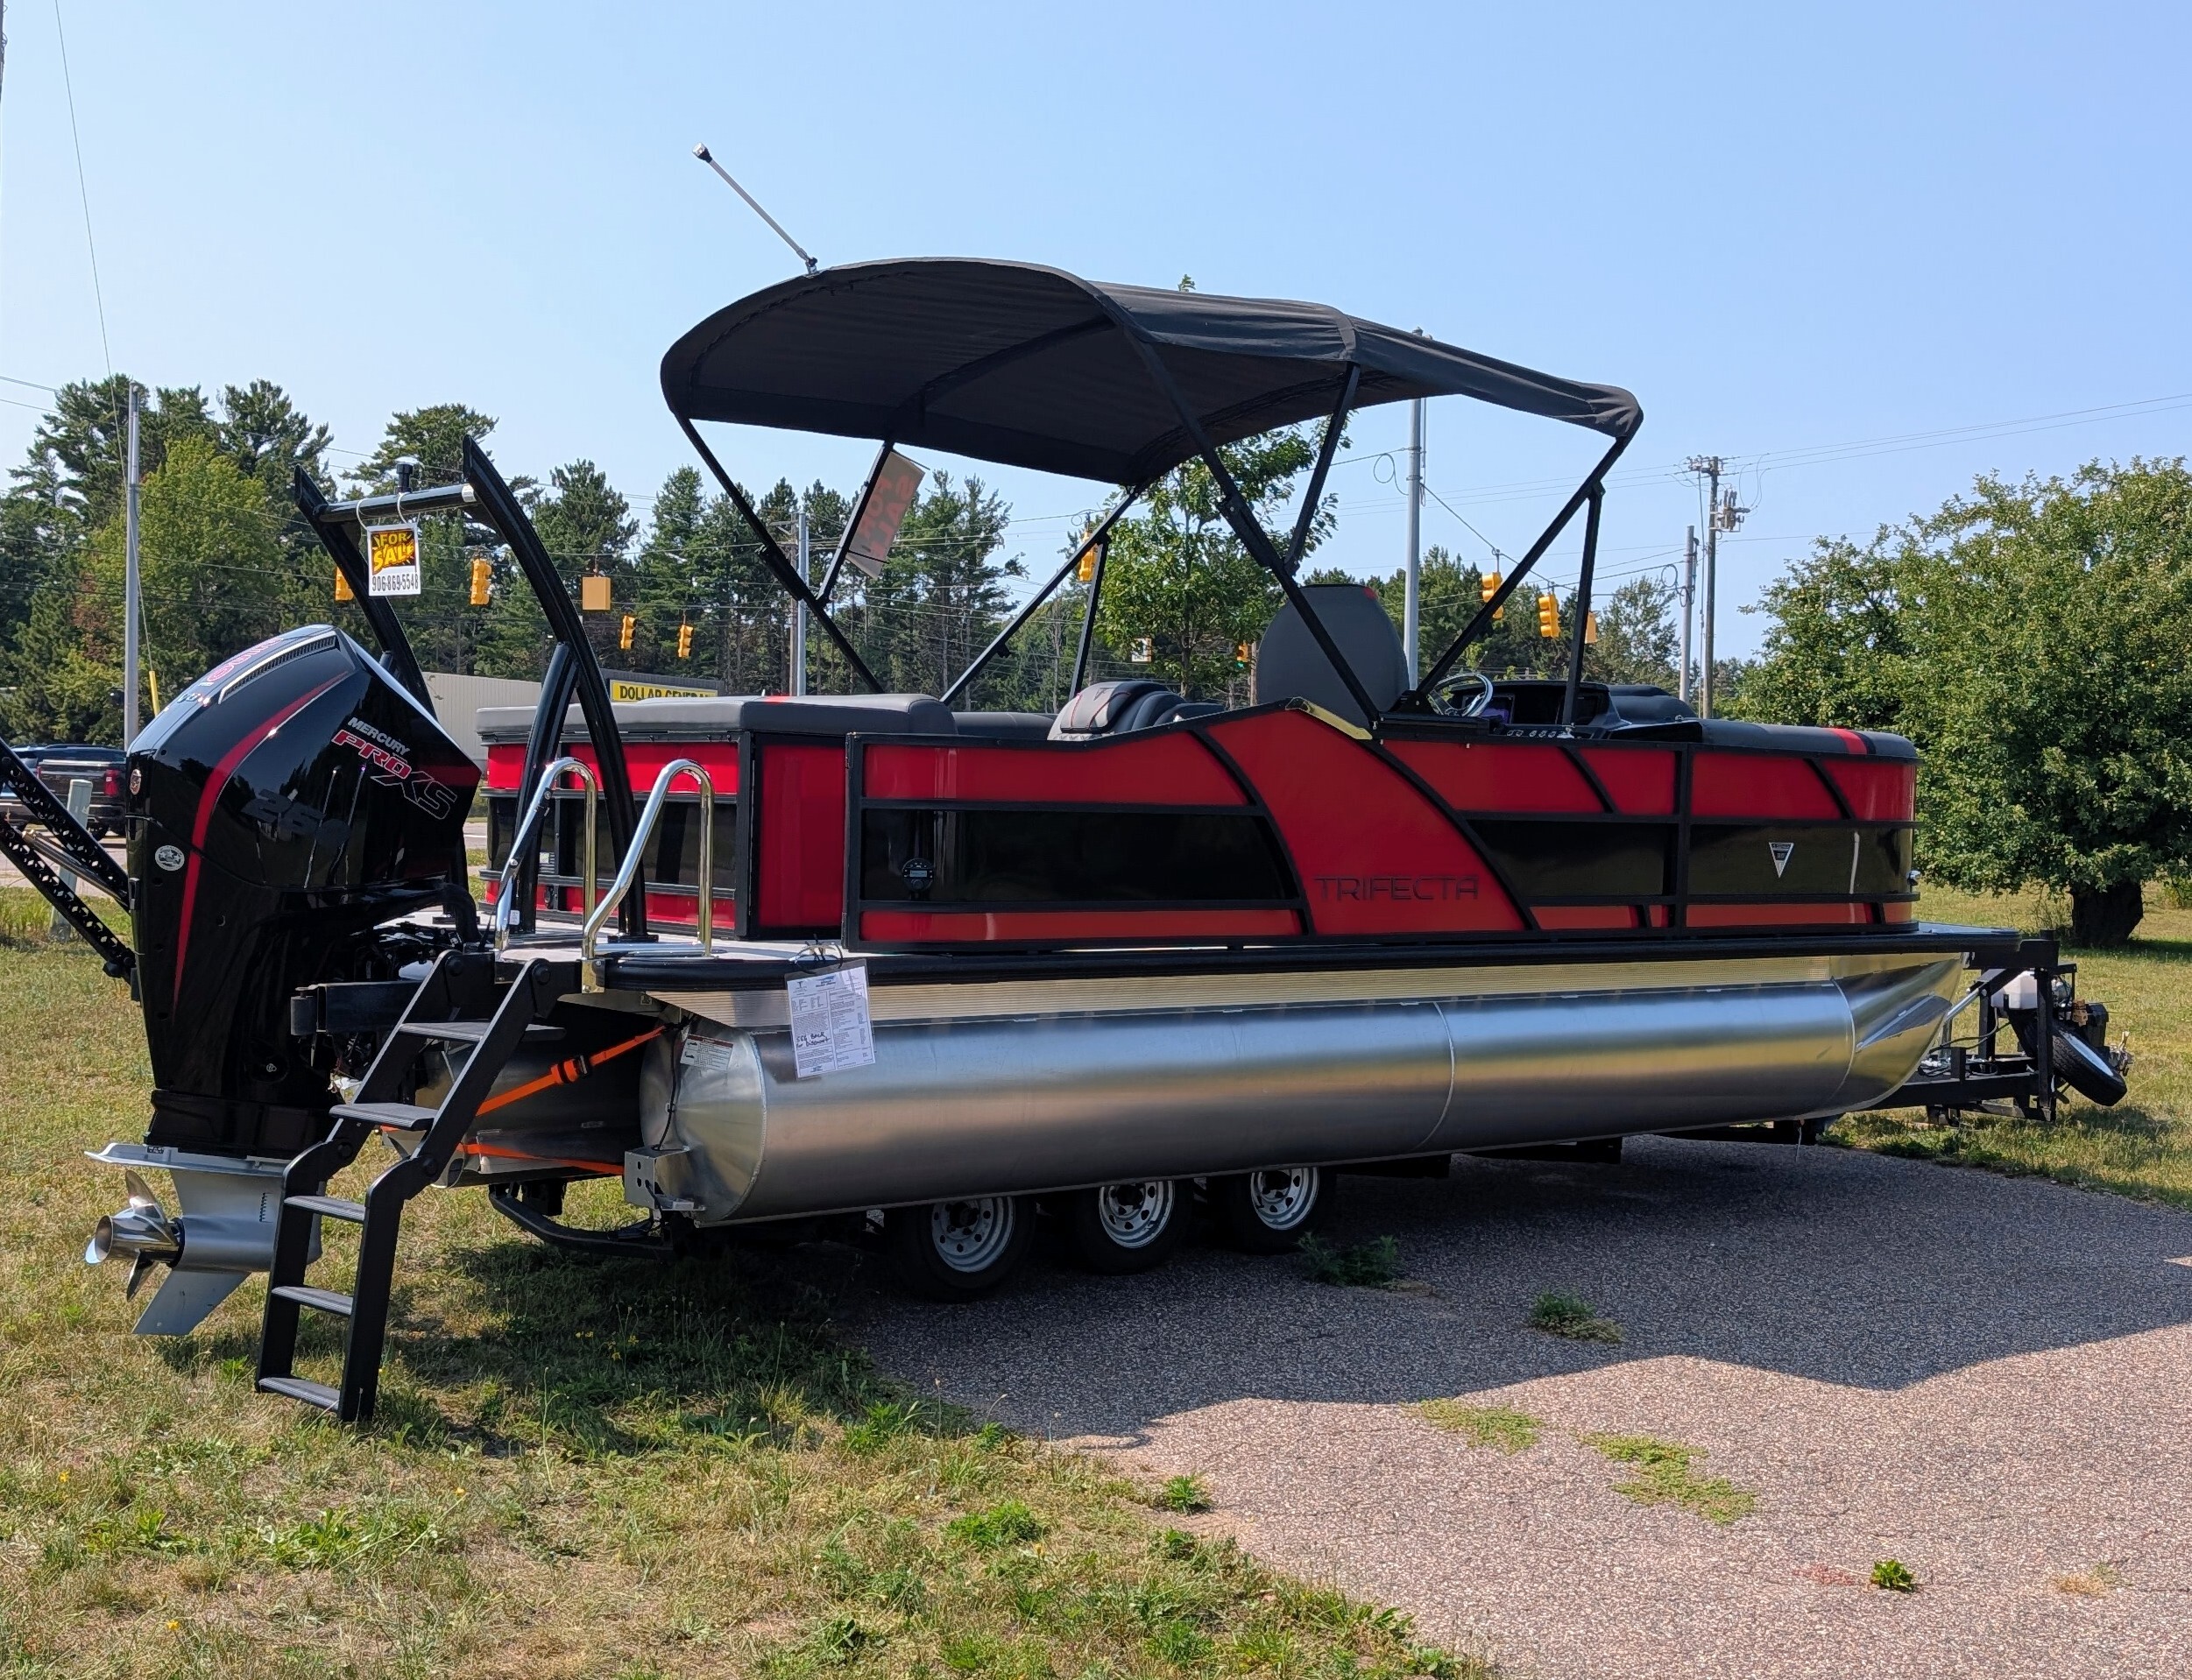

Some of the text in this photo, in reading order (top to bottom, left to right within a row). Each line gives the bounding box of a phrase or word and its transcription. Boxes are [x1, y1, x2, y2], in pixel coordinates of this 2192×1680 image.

[379, 533, 407, 547] FOR
[373, 540, 414, 572] SALE
[372, 574, 419, 591] 906-869-5548
[619, 685, 661, 700] DOLLAR
[348, 717, 410, 756] MERCURY
[331, 730, 457, 820] PRO XS
[1314, 877, 1479, 901] TRIFECTA
